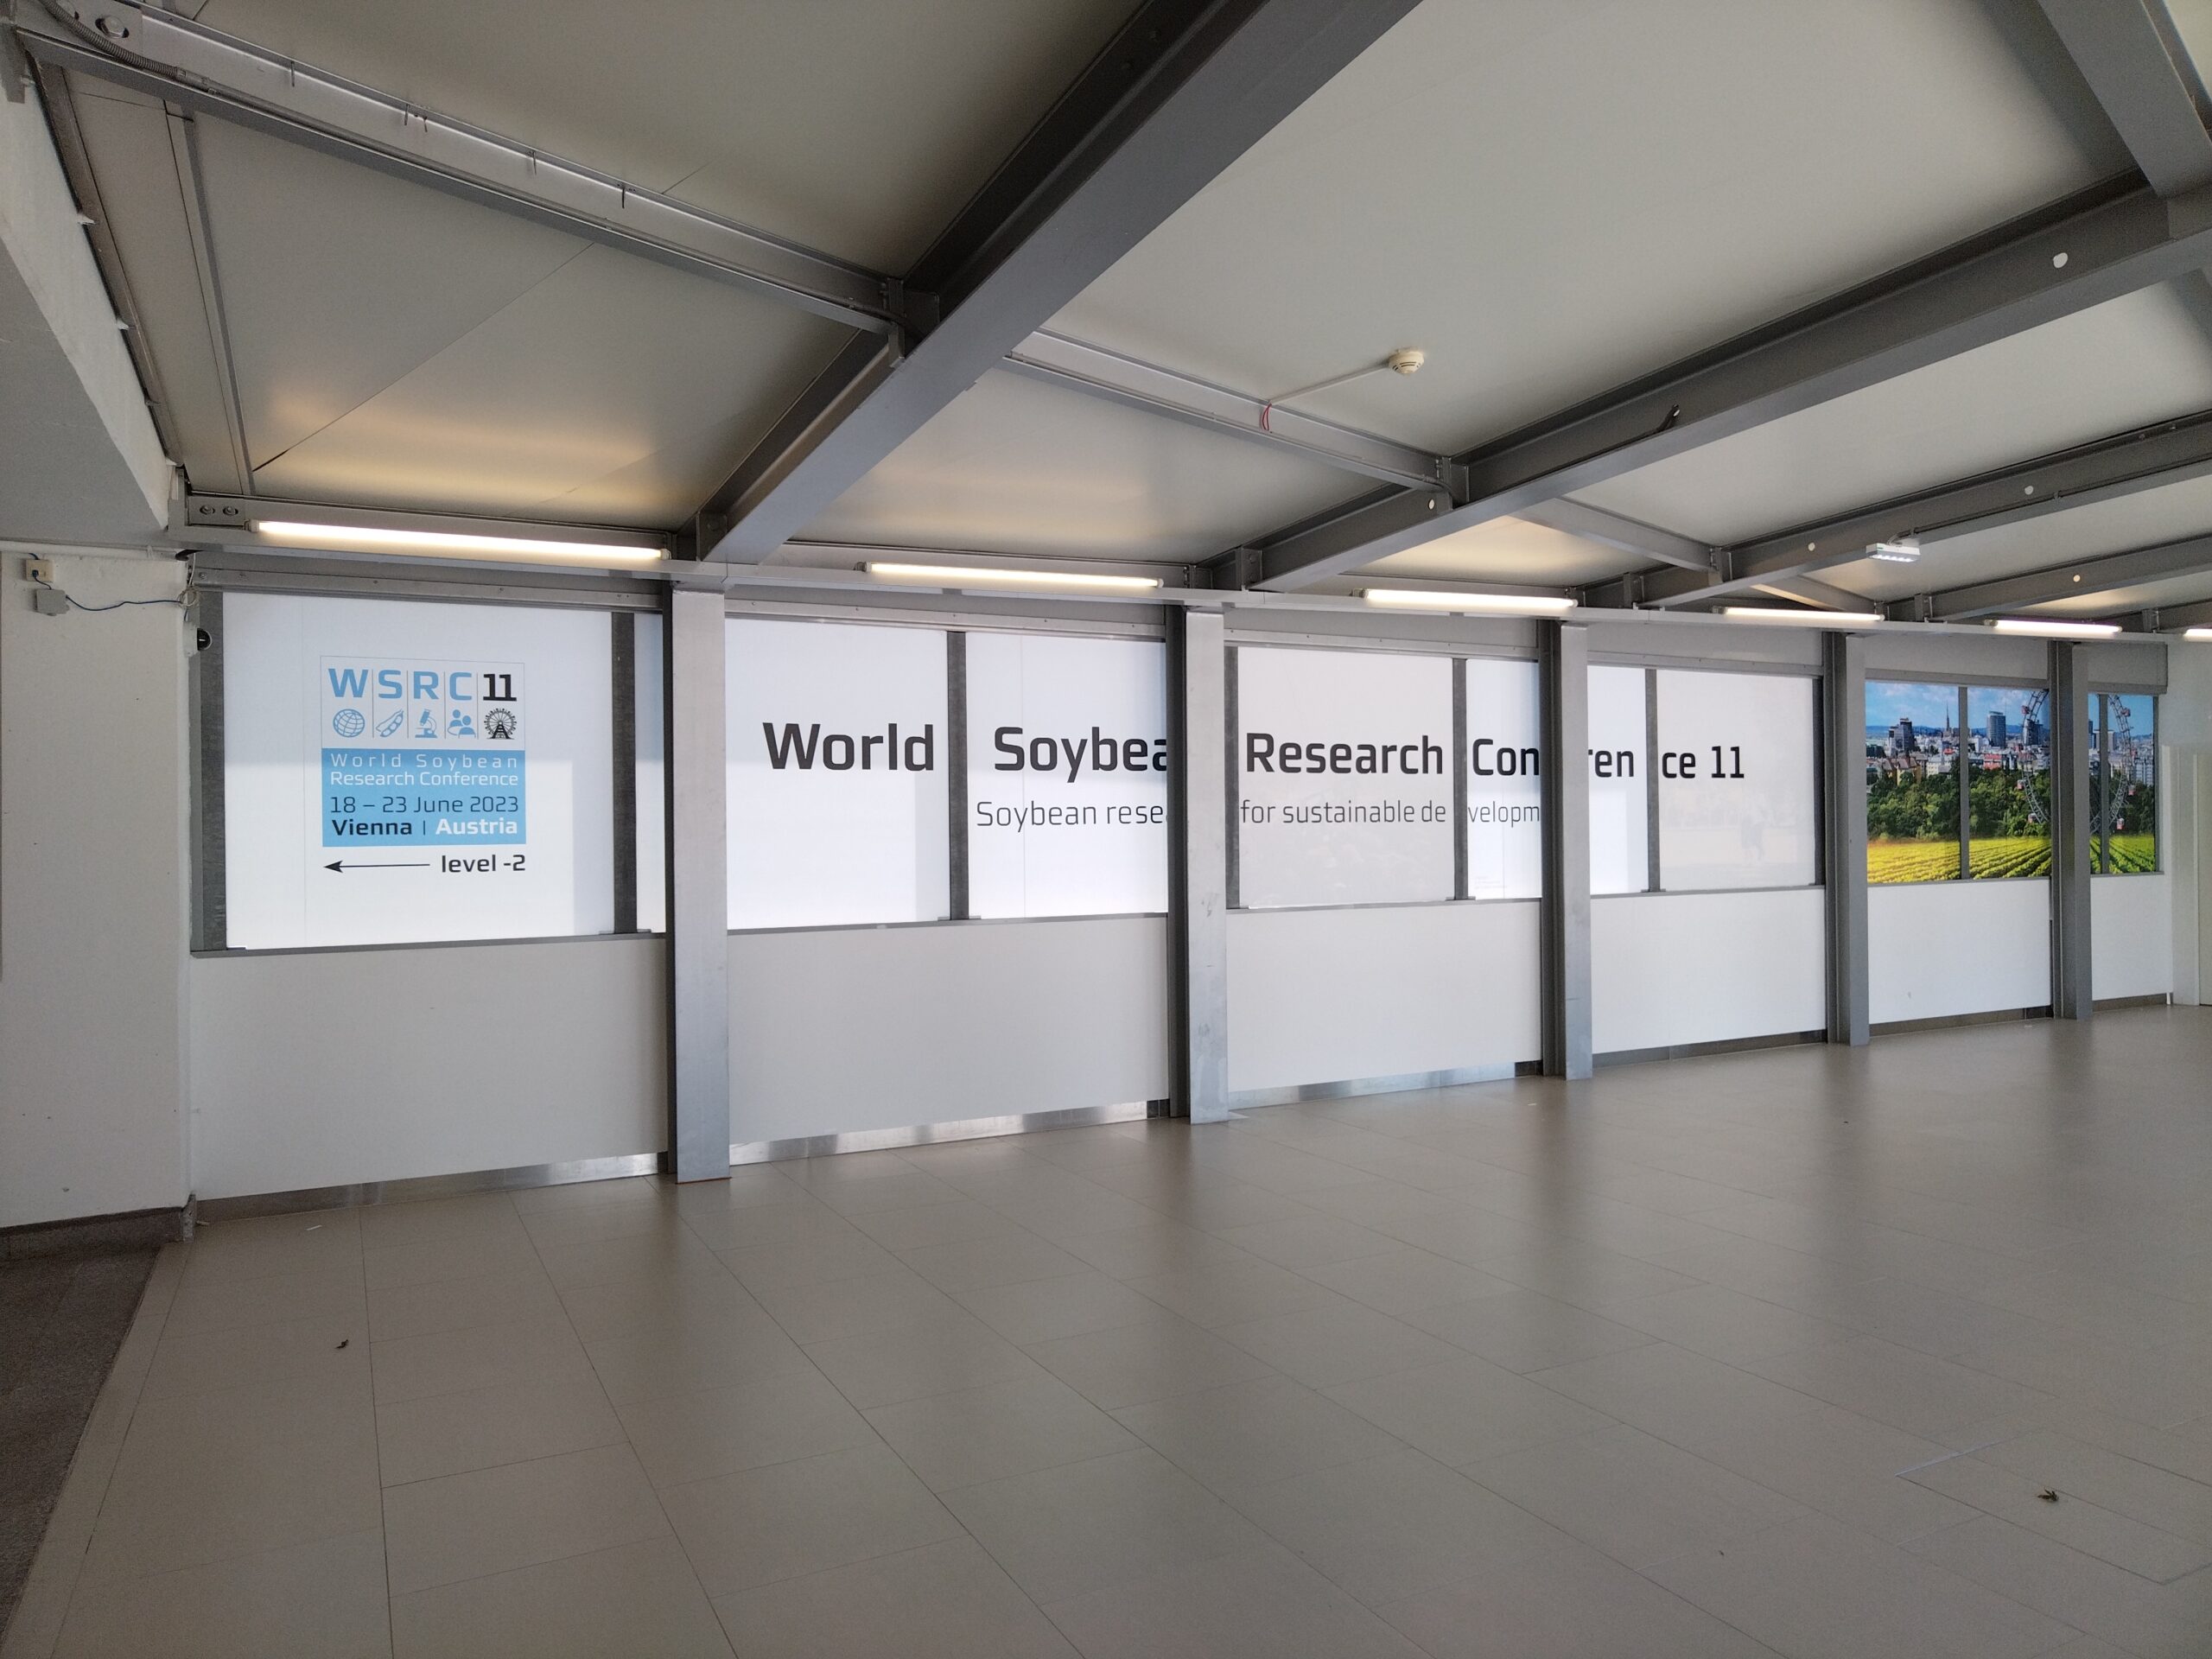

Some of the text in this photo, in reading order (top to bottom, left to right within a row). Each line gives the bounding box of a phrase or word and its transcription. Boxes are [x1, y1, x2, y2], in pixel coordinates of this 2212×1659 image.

[482, 673, 518, 702] 11
[330, 753, 518, 771] World Soybean
[762, 722, 934, 772] World
[994, 726, 1166, 783] Soybea
[1246, 732, 1443, 775] Research
[1472, 738, 1540, 776] Con
[1662, 752, 1696, 779] ce
[1711, 746, 1745, 779] 11
[330, 771, 518, 785] Research Conference
[330, 796, 356, 813] 18
[382, 796, 407, 813] 23
[413, 796, 464, 813] June
[470, 796, 518, 813] 2023
[976, 799, 1540, 833] Soybean rese for sustainable de velopm
[332, 817, 518, 836] Vienna Austria
[442, 854, 526, 873] level -2
